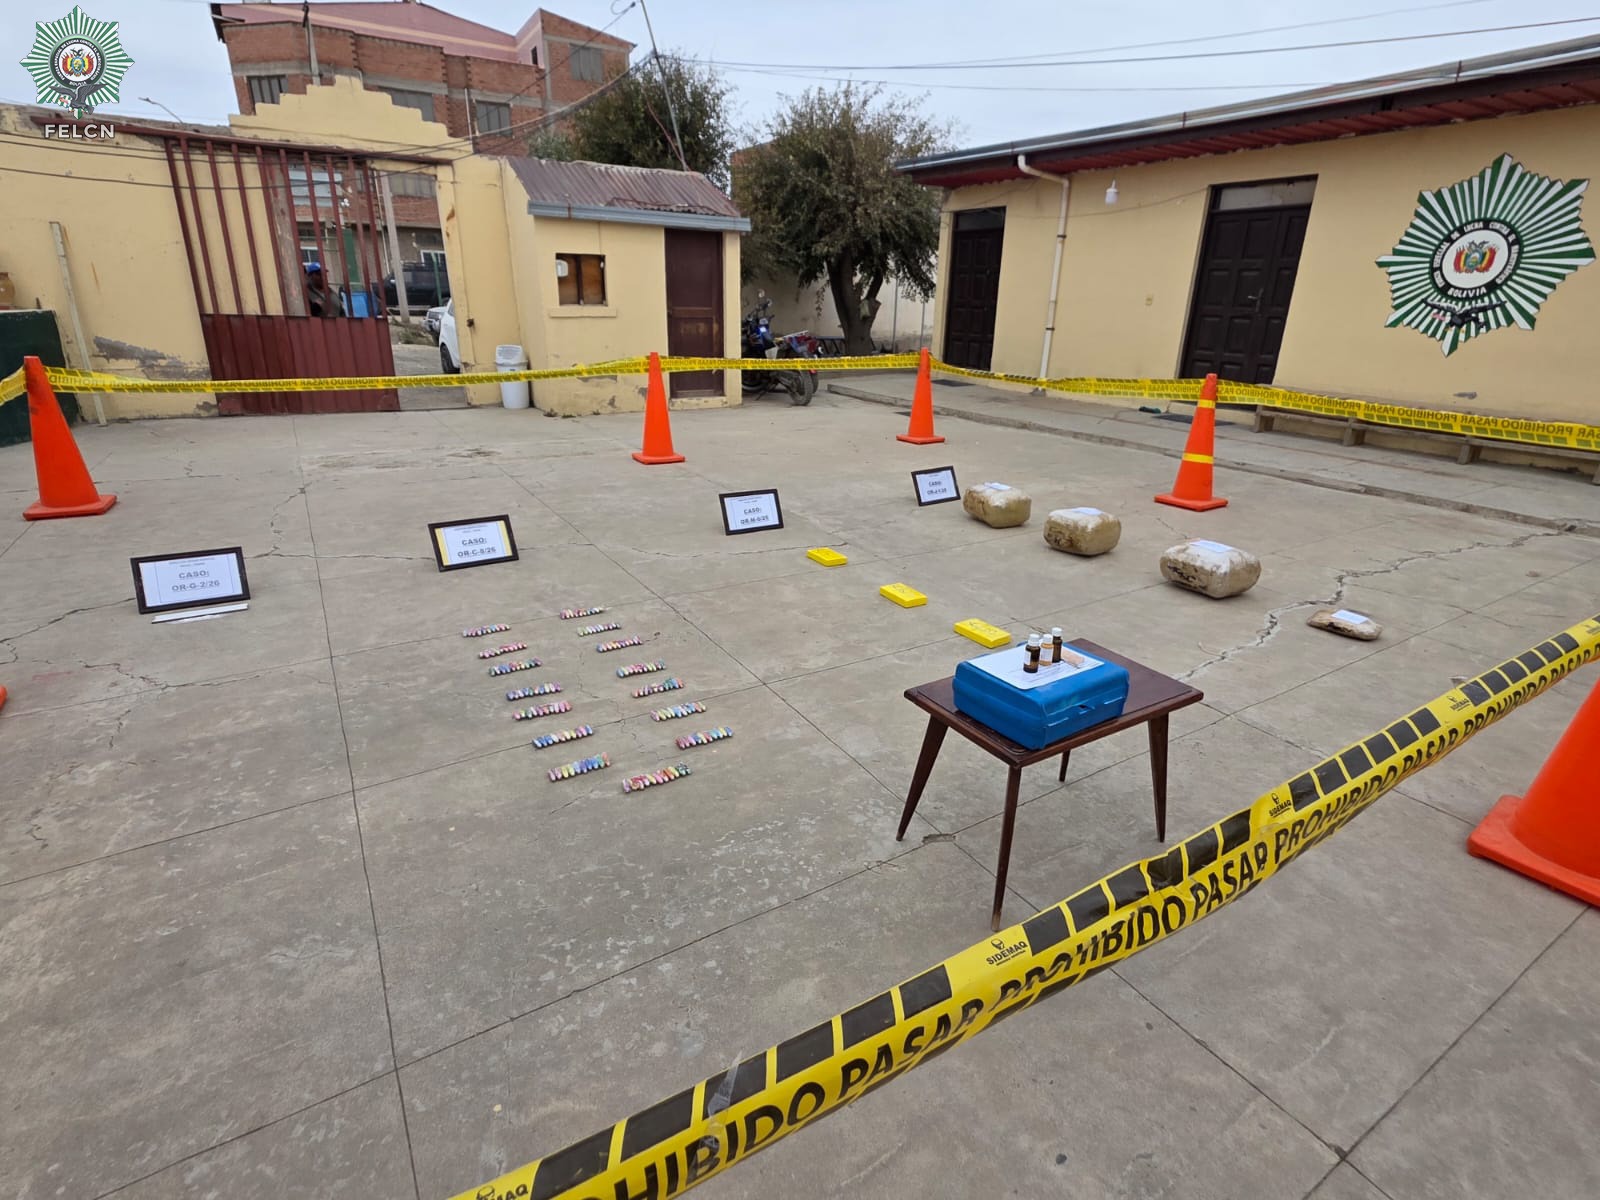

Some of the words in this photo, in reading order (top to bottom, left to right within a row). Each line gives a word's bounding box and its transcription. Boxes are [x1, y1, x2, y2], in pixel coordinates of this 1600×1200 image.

[1447, 286, 1487, 298] BOLIVIA
[461, 537, 487, 546] CASO:
[178, 570, 210, 580] CASO:
[1189, 841, 1269, 922] PASAR
[986, 941, 1028, 965] SIDEMAQ
